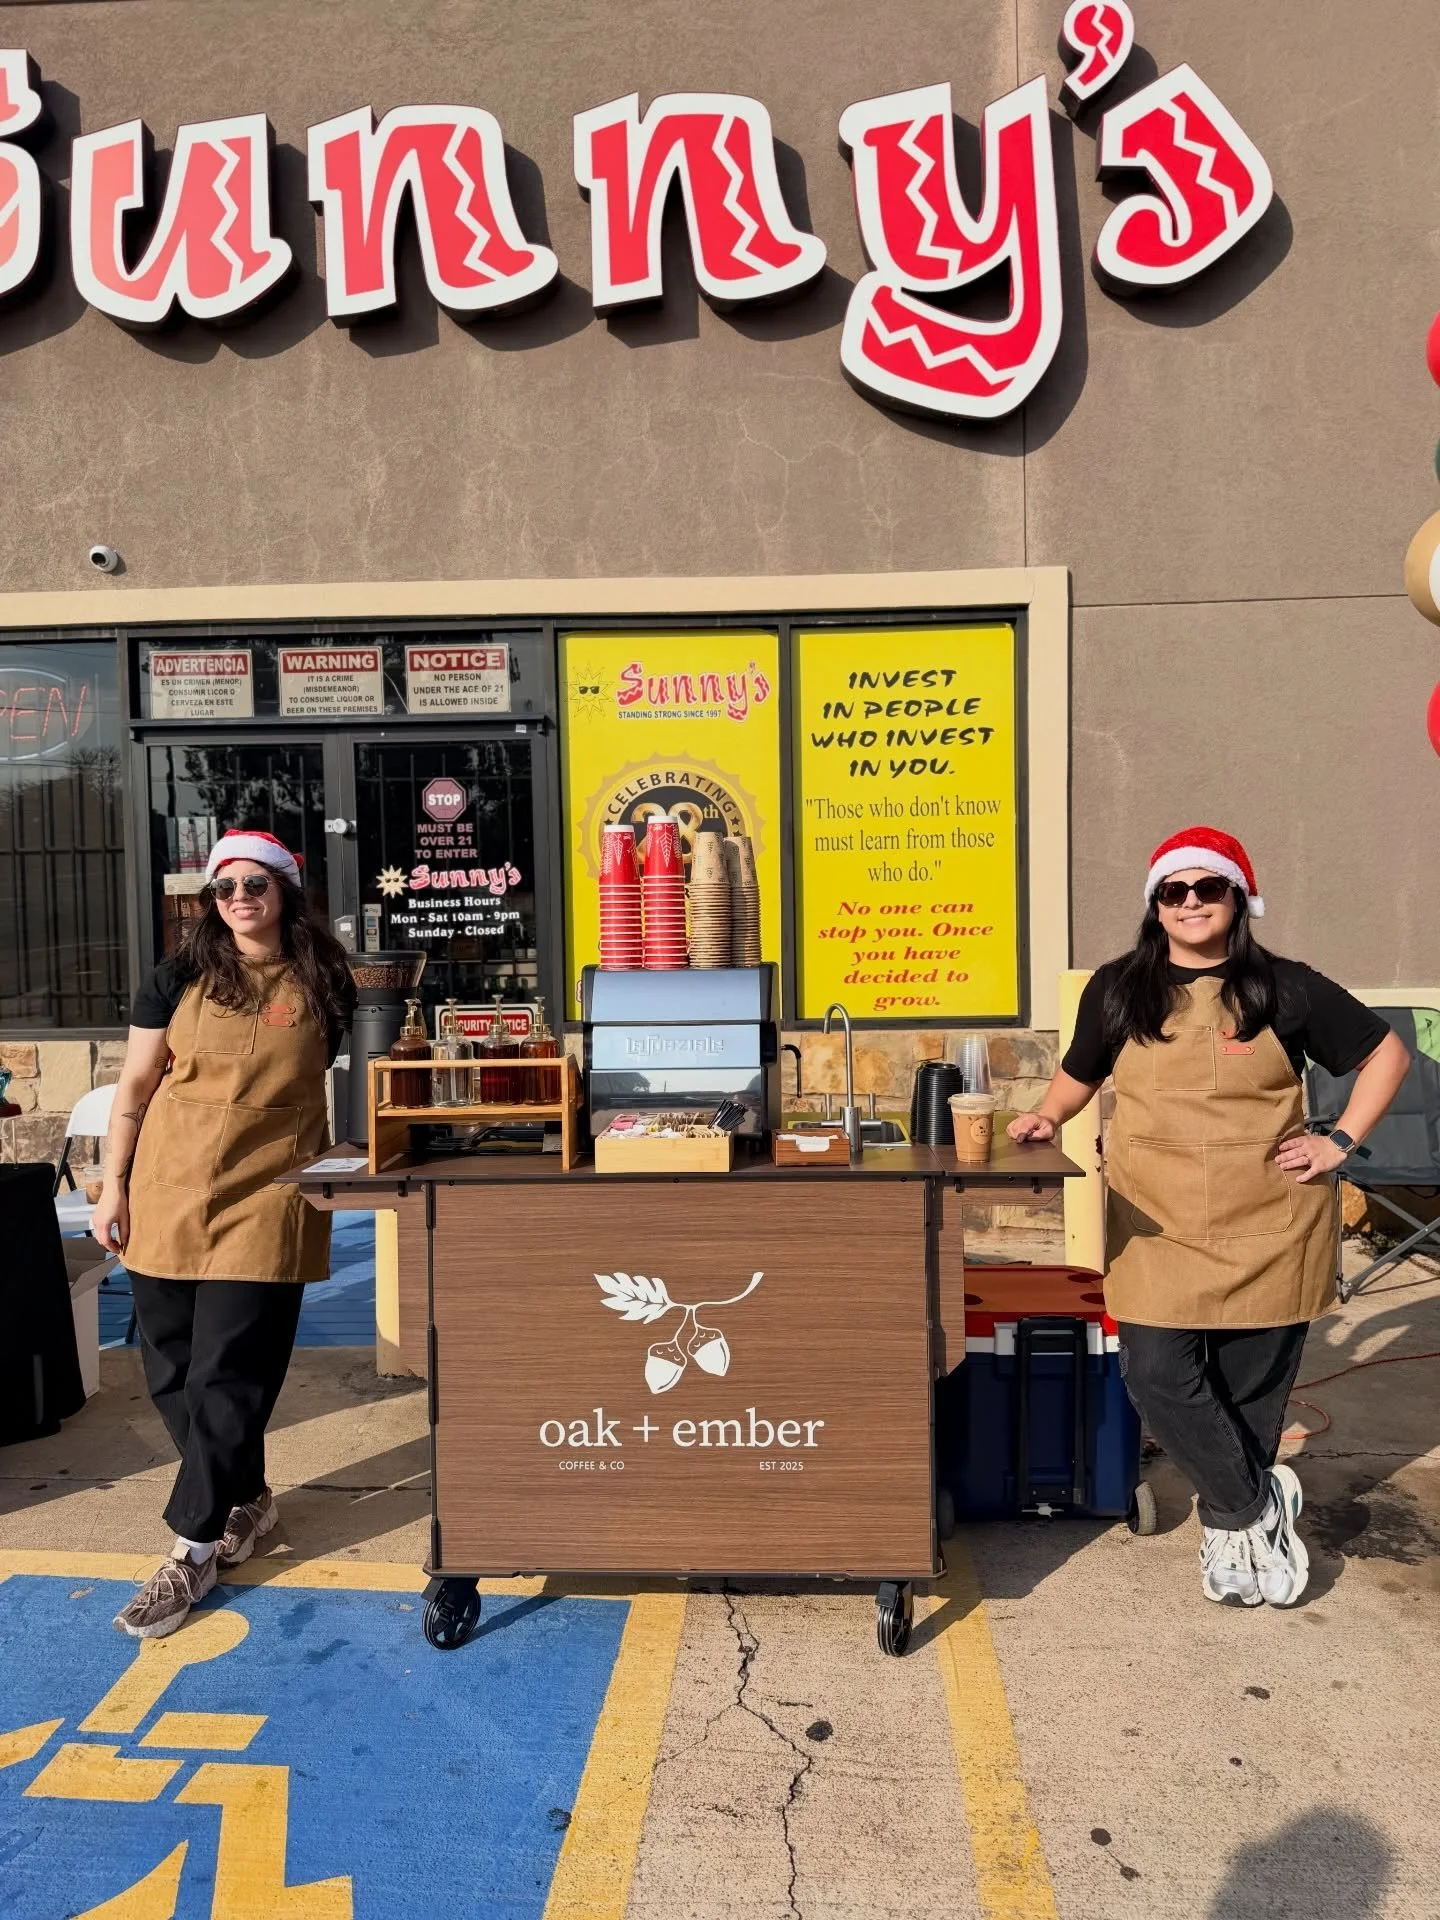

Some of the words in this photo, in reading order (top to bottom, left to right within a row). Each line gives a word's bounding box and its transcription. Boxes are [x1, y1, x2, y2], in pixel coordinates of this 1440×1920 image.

[156, 657, 246, 673] ADVERTENCIA
[286, 654, 375, 670] WARNING
[413, 652, 501, 668] NOTICE
[434, 673, 446, 681] NO
[448, 673, 482, 681] PERSON
[848, 669, 957, 690] INVEST
[303, 685, 360, 694] (MISDEMEANOR)
[413, 686, 441, 694] UNDER
[444, 686, 460, 694] THE
[462, 685, 479, 693] AGE
[616, 660, 771, 723] Sunny's
[336, 695, 363, 703] LIQUOR
[429, 698, 468, 706] ALLOWED
[470, 697, 499, 705] INSIDE
[618, 710, 653, 719] STANDING
[654, 710, 682, 719] STRONG
[684, 710, 704, 718] SINCE
[706, 709, 721, 718] 1997
[823, 701, 854, 719] IN
[863, 697, 982, 719] PEOPLE
[811, 730, 878, 749] WHO
[886, 727, 995, 747] INVEST
[850, 759, 881, 777] IN
[889, 758, 955, 778] YOU.
[428, 794, 461, 806] STOP
[607, 771, 737, 815] CELEBRATING
[805, 798, 864, 819] "Those
[868, 796, 904, 818] who
[909, 795, 950, 817] don't
[954, 794, 1002, 816] know
[417, 823, 453, 833] MUST
[456, 823, 474, 833] BE
[420, 836, 454, 846] OVER
[457, 835, 472, 846] 21
[814, 833, 854, 851] must
[859, 829, 900, 850] learn
[906, 827, 945, 849] from
[951, 827, 995, 848] those
[414, 849, 432, 859] TO
[435, 849, 478, 859] ENTER
[409, 861, 522, 895] Sunny's
[868, 860, 903, 882] who
[908, 859, 942, 881] do."
[408, 898, 461, 909] Business
[464, 897, 501, 907] Hours
[836, 901, 871, 916] No
[879, 904, 922, 915] one
[930, 903, 974, 914] can
[390, 914, 417, 924] Mon
[428, 912, 448, 922] Sat
[452, 912, 484, 922] 10am
[493, 911, 520, 923] 9pm
[408, 927, 454, 939] Sunday
[465, 925, 505, 936] Closed
[817, 925, 867, 943] stop
[872, 927, 924, 943] you.
[932, 922, 994, 937] Once
[850, 950, 896, 966] you
[903, 946, 961, 960] have
[843, 968, 939, 985] decided
[946, 969, 969, 983] to
[873, 995, 941, 1012] grow.
[539, 1407, 623, 1448] oak
[632, 1415, 660, 1443] +
[672, 1407, 825, 1448] ember
[559, 1461, 595, 1471] COFFEE
[598, 1461, 607, 1471] &
[610, 1461, 625, 1471] CO
[759, 1461, 776, 1471] EST
[780, 1461, 804, 1471] 2025
